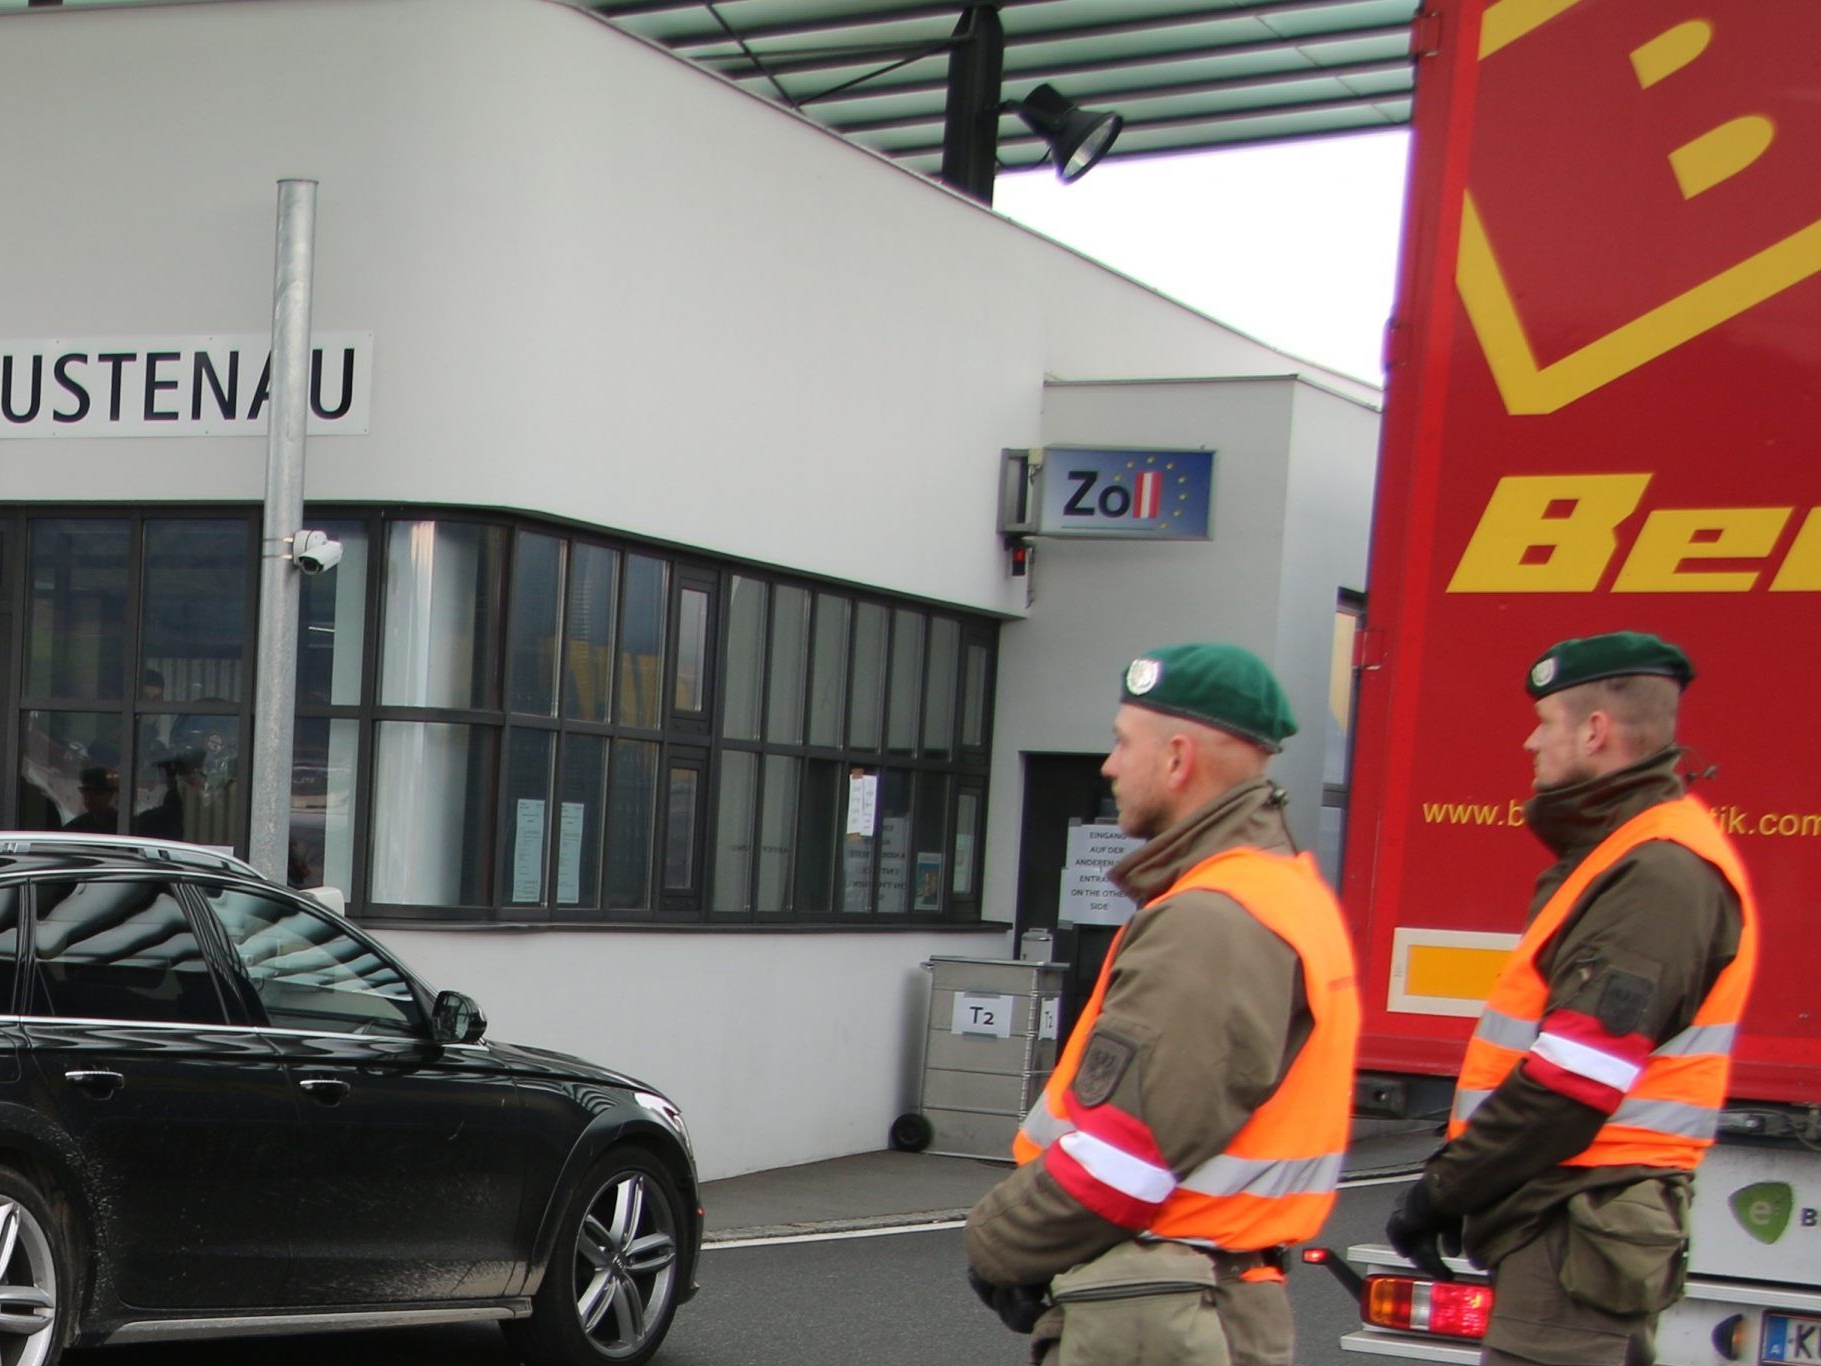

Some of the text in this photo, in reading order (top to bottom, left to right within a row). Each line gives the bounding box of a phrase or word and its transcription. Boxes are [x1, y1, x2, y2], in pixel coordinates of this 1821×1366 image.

[1063, 470, 1163, 518] Zoll
[1102, 890, 1126, 898] OTHE
[969, 1006, 995, 1026] T2
[1793, 1324, 1821, 1359] K
